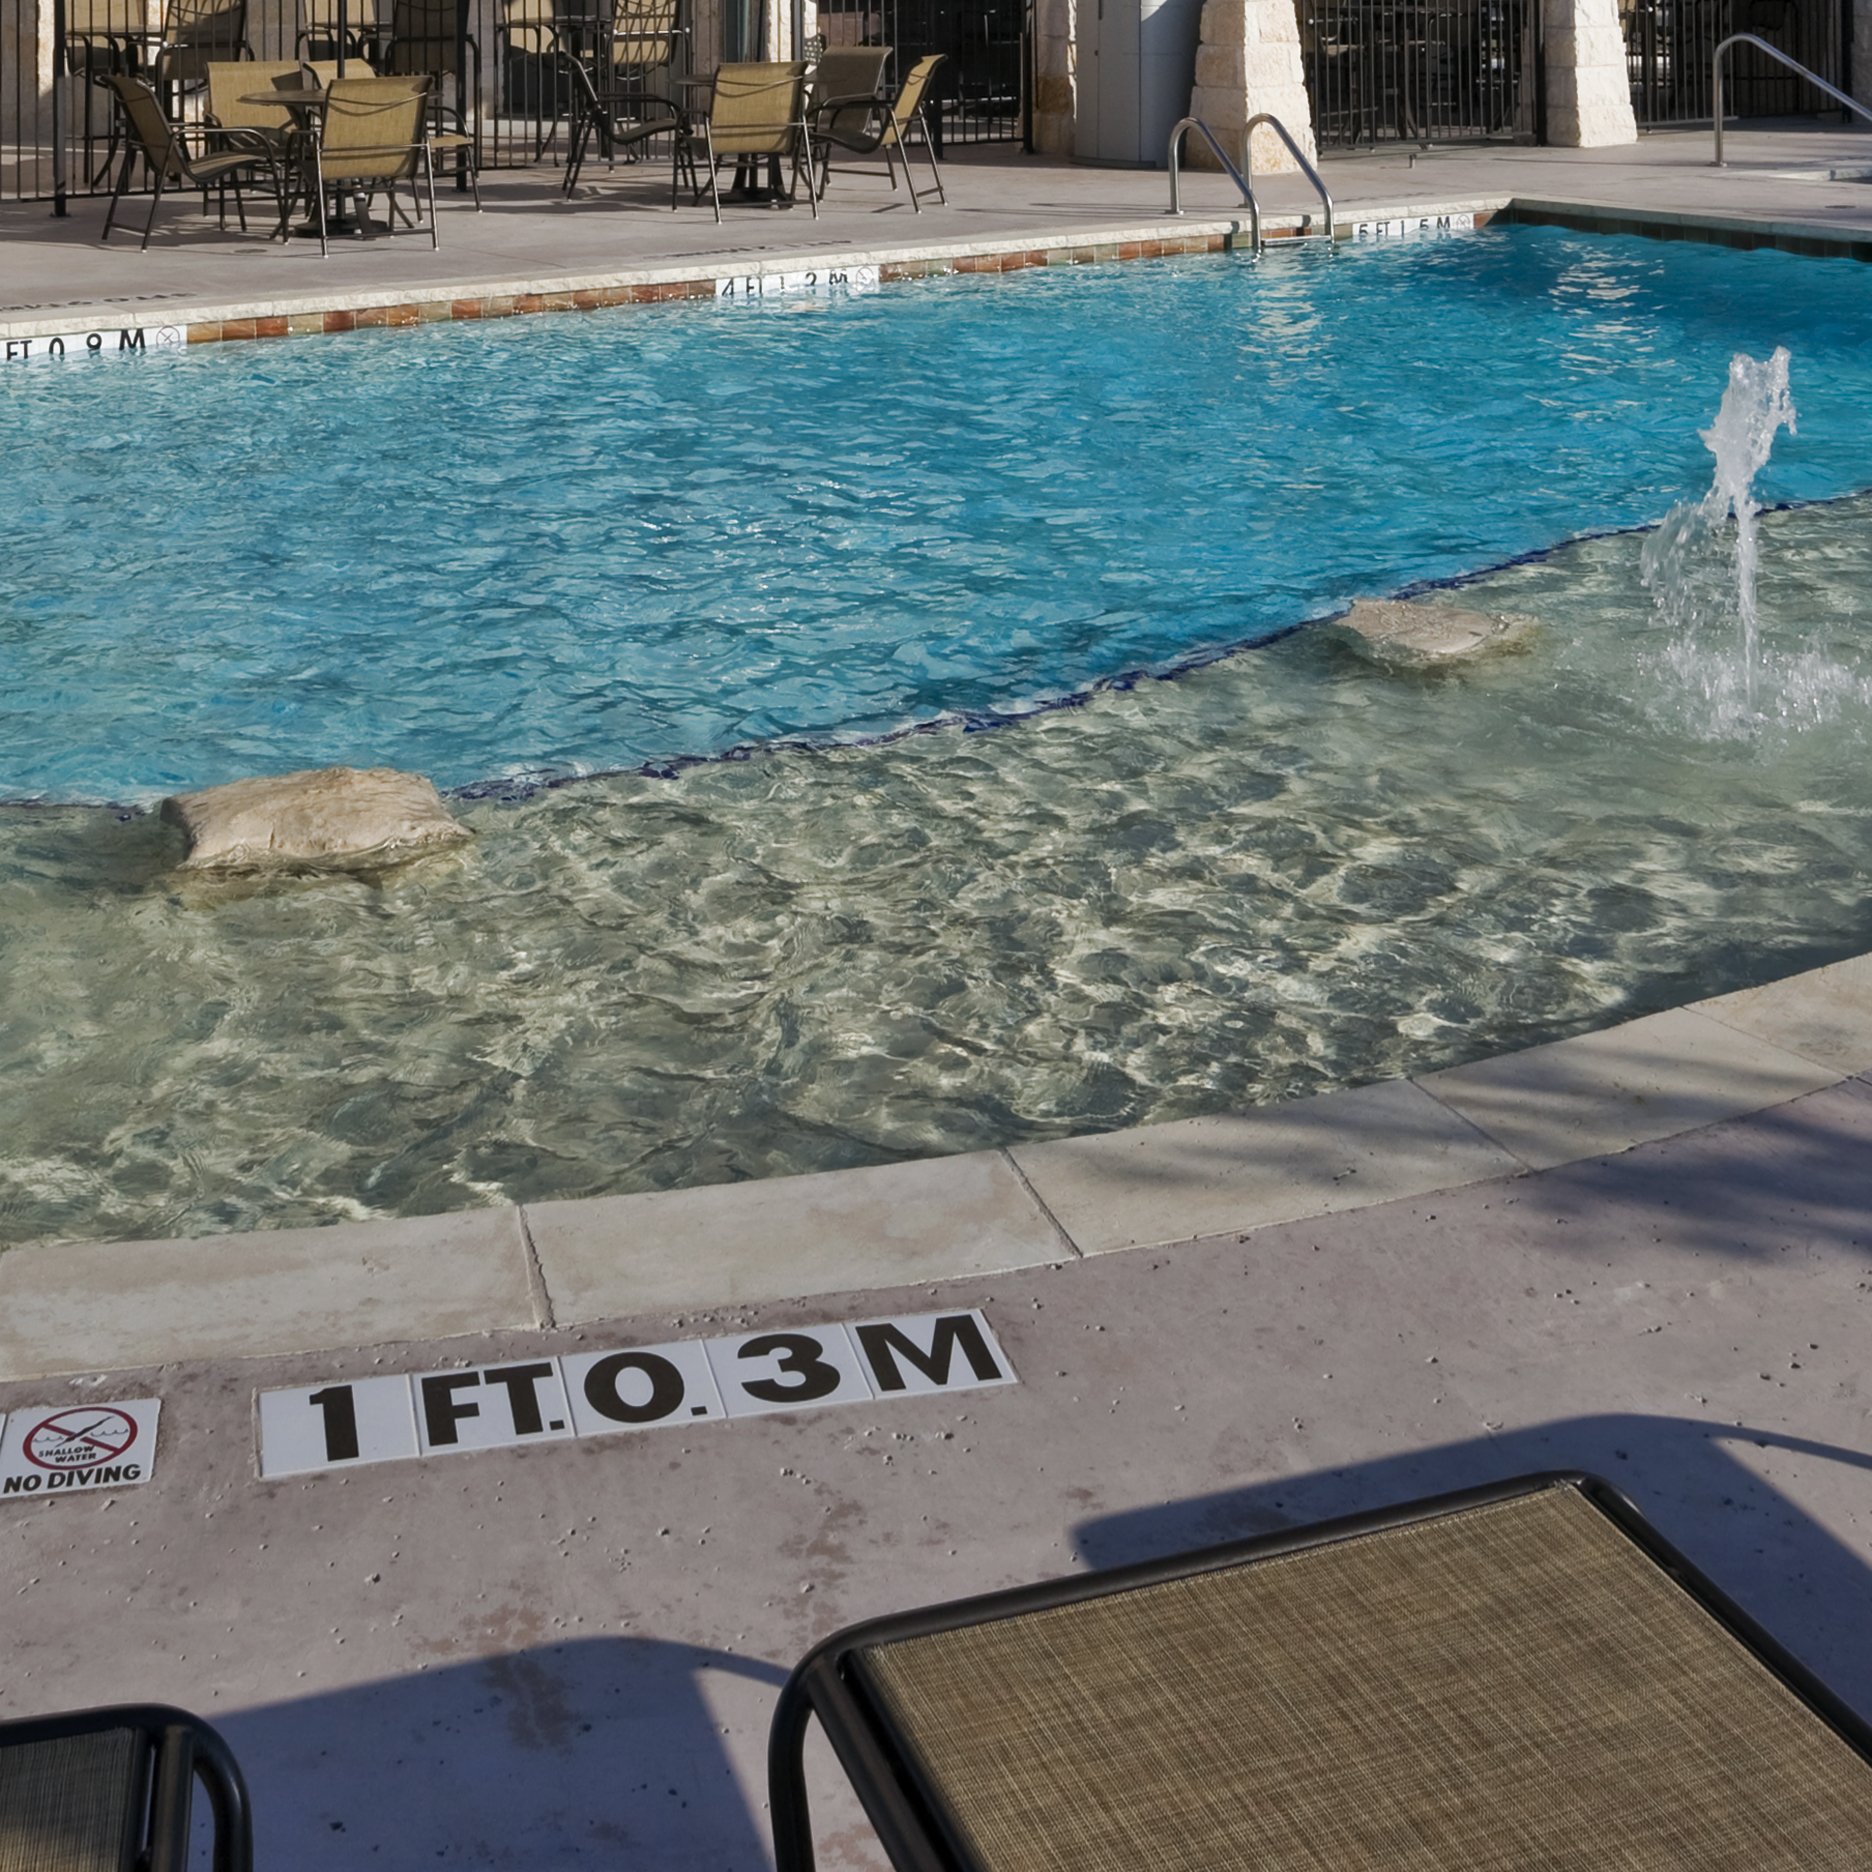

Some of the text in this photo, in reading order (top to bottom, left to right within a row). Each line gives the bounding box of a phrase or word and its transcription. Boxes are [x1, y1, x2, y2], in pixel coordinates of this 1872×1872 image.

[7, 340, 32, 360] FT
[119, 328, 146, 350] M
[308, 1384, 360, 1462] 1
[39, 1445, 96, 1458] SHALLOW
[54, 1453, 97, 1463] WATER
[3, 1463, 142, 1494] NO DIVING
